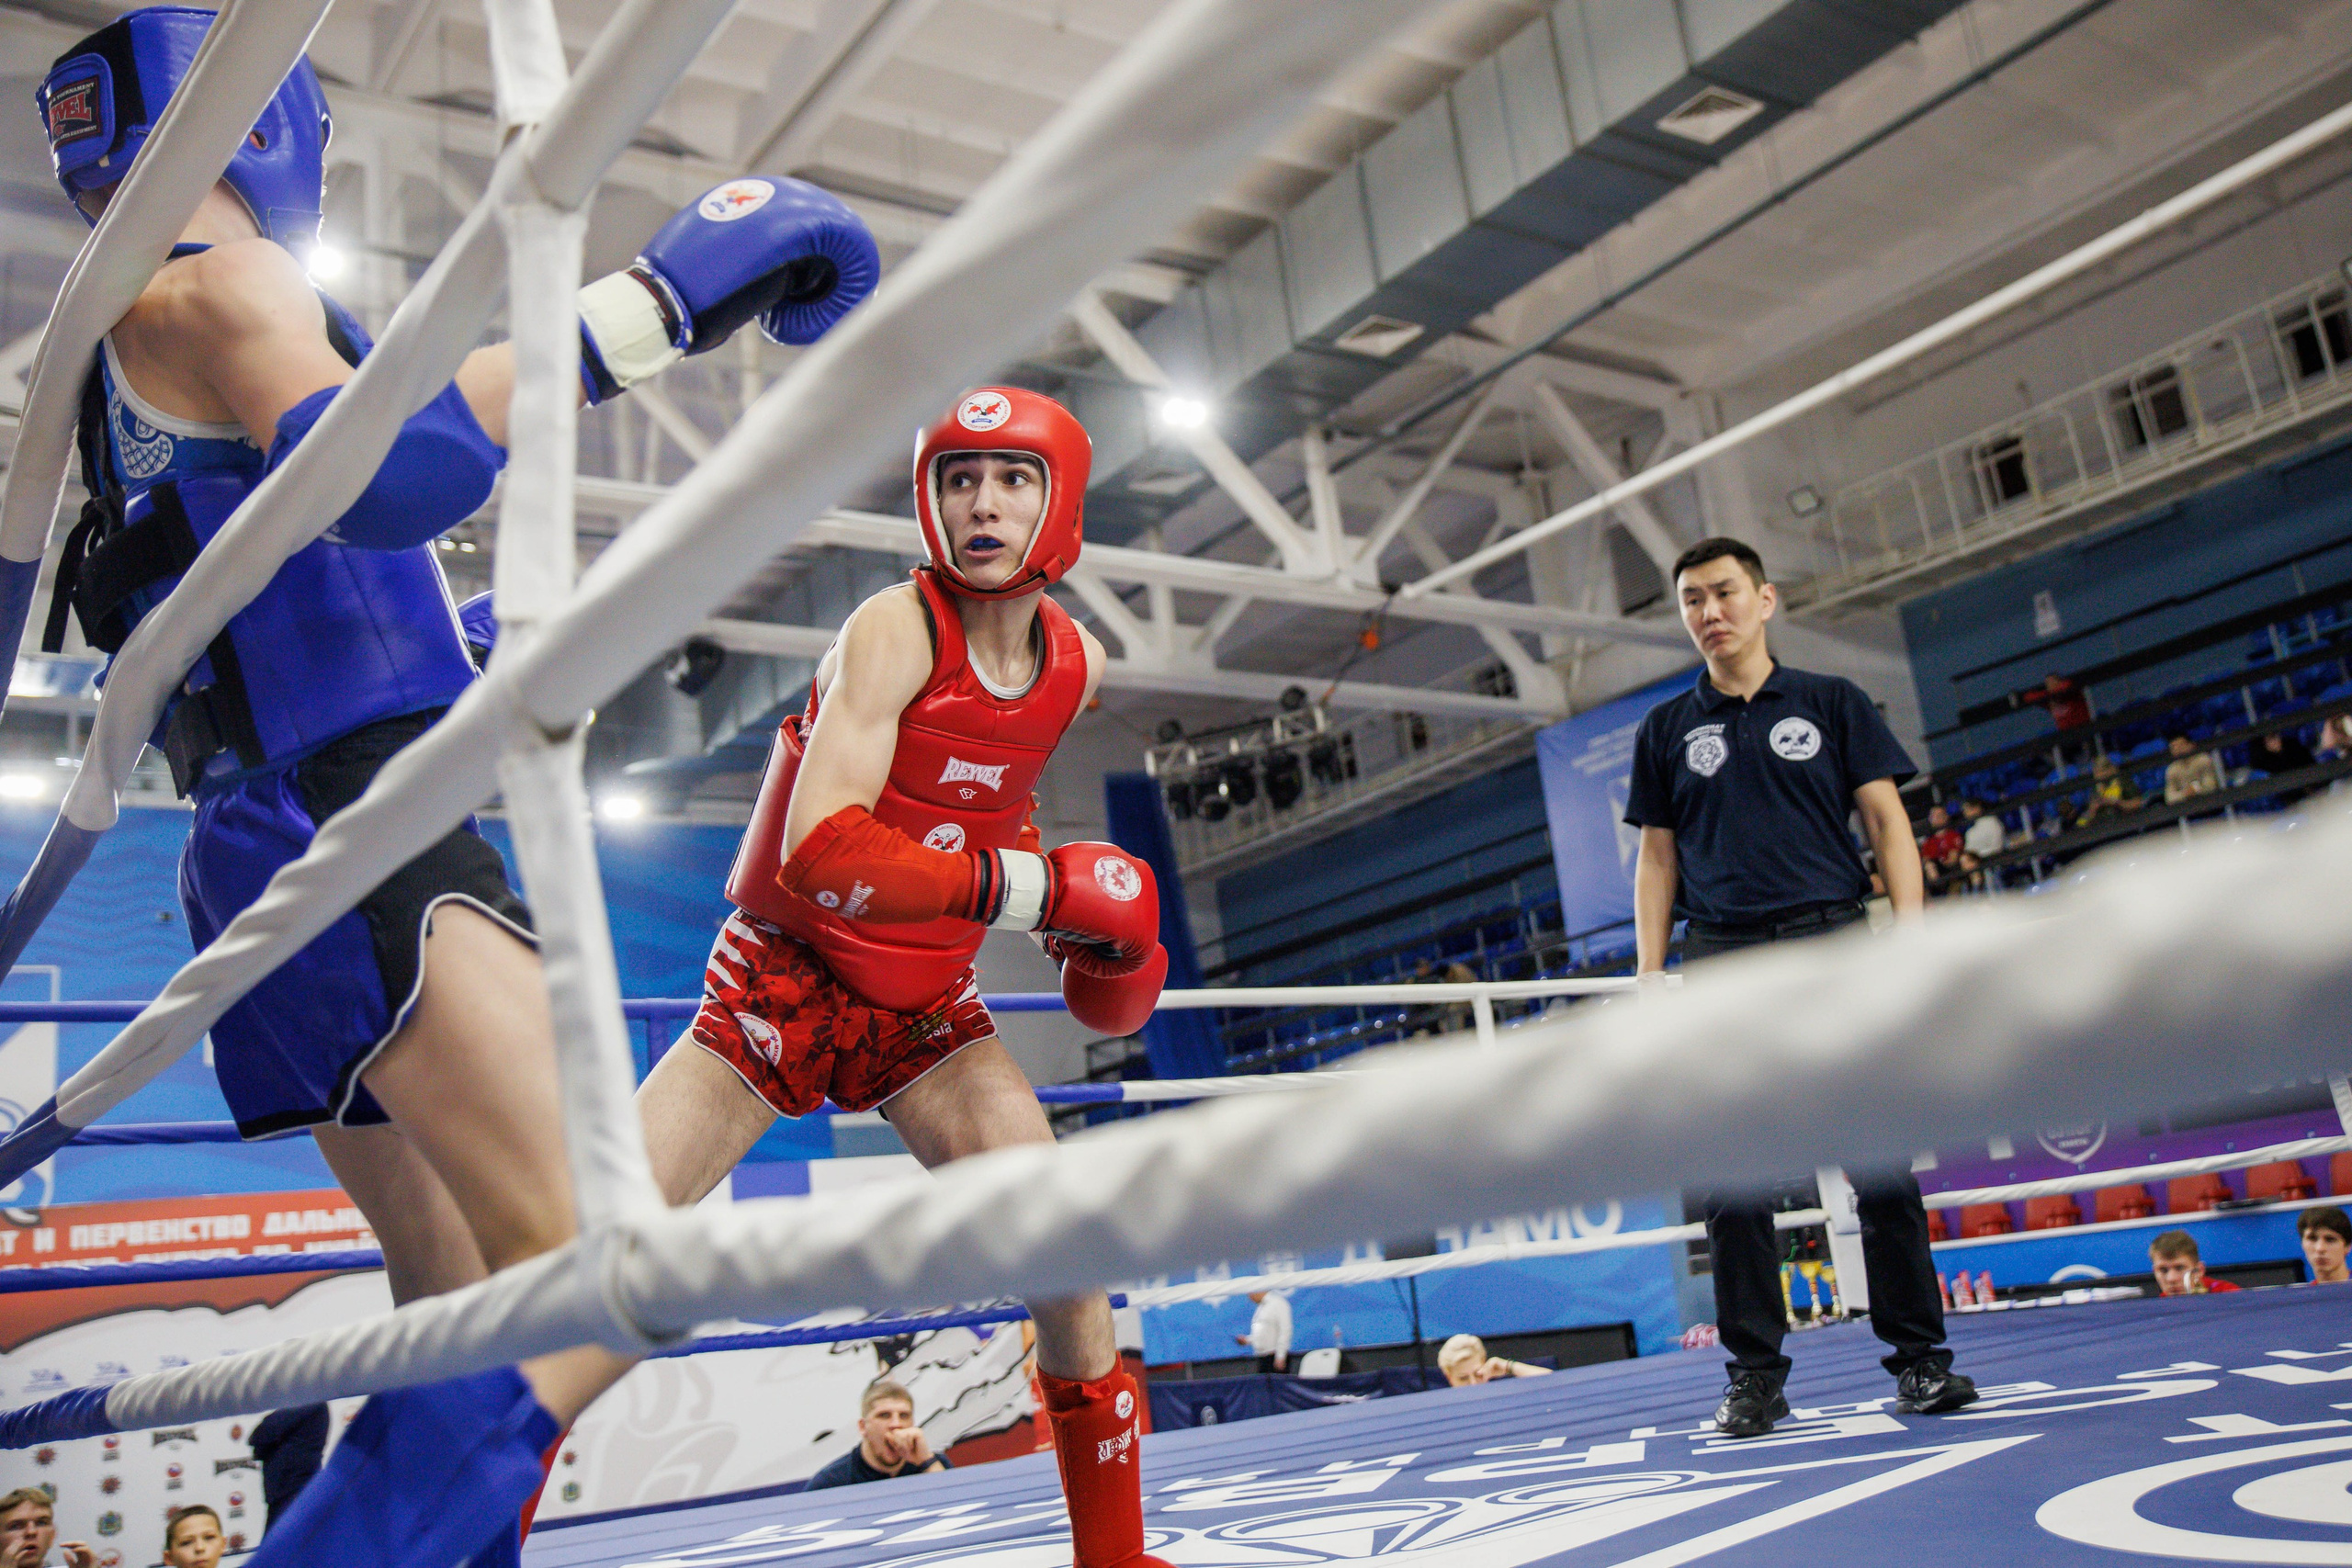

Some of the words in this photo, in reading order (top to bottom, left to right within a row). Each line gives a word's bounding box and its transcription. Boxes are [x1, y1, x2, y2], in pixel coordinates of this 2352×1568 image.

[938, 756, 1005, 793] REYVEL
[33, 1227, 56, 1254] И
[70, 1214, 251, 1250] ПЕРВЕНСТВО
